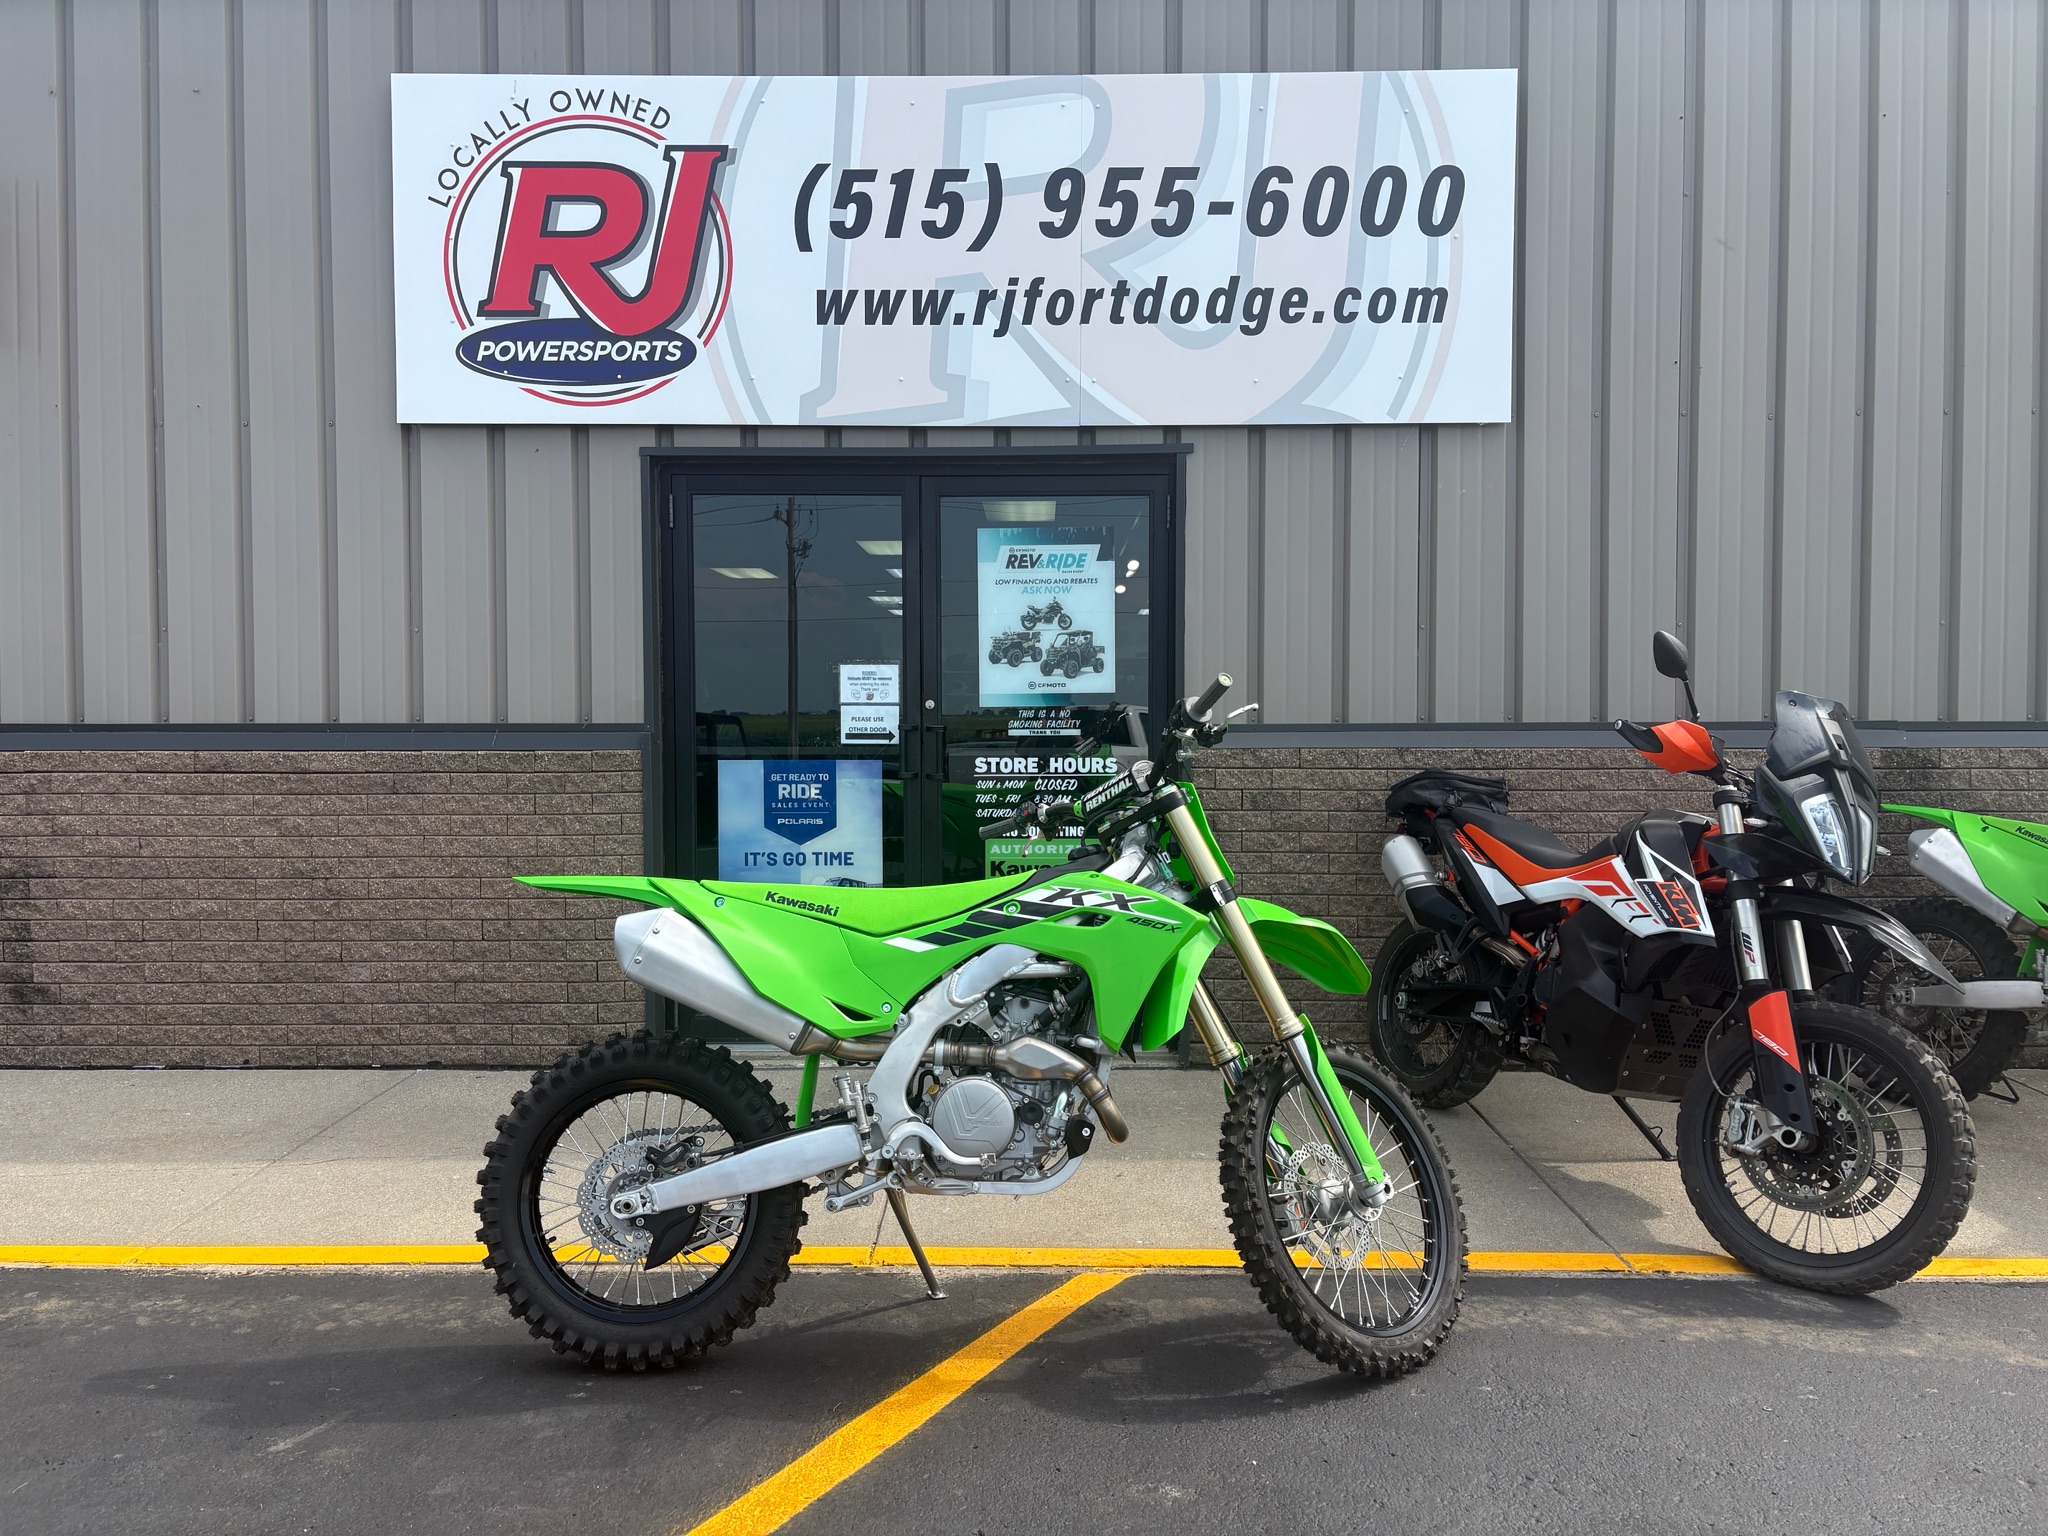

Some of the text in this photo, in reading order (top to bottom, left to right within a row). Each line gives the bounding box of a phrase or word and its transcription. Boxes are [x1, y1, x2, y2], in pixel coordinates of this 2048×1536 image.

[427, 88, 671, 209] LOCALLY OWNED
[793, 162, 1466, 253] (515) 955-6000
[476, 144, 732, 337] RJ
[815, 275, 1450, 338] www.rjfortdodge.com
[476, 339, 683, 363] POWERSPORTS
[1021, 586, 1072, 594] ASK NOW
[1008, 720, 1081, 728] SMOKING FACILITY
[1018, 710, 1071, 718] THIS IS A NO
[770, 773, 829, 781] GET READY TO
[974, 757, 1118, 774] STORE HOURS
[778, 783, 823, 800] RIDE
[976, 780, 996, 789] SUN
[1003, 780, 1027, 789] MON
[1034, 779, 1078, 791] CLOSED
[1085, 776, 1133, 812] RENTHAL
[975, 794, 998, 803] TUES
[1005, 794, 1021, 803] FRI
[975, 808, 1017, 818] SATURDA
[744, 851, 855, 867] IT'S GO TIME
[765, 890, 840, 917] Kawasaki
[1039, 886, 1156, 914] KX
[1643, 884, 1670, 919] ADVENTURE
[1655, 881, 1701, 928] KTM
[1741, 931, 1756, 964] WP
[1754, 1029, 1789, 1056] 790
